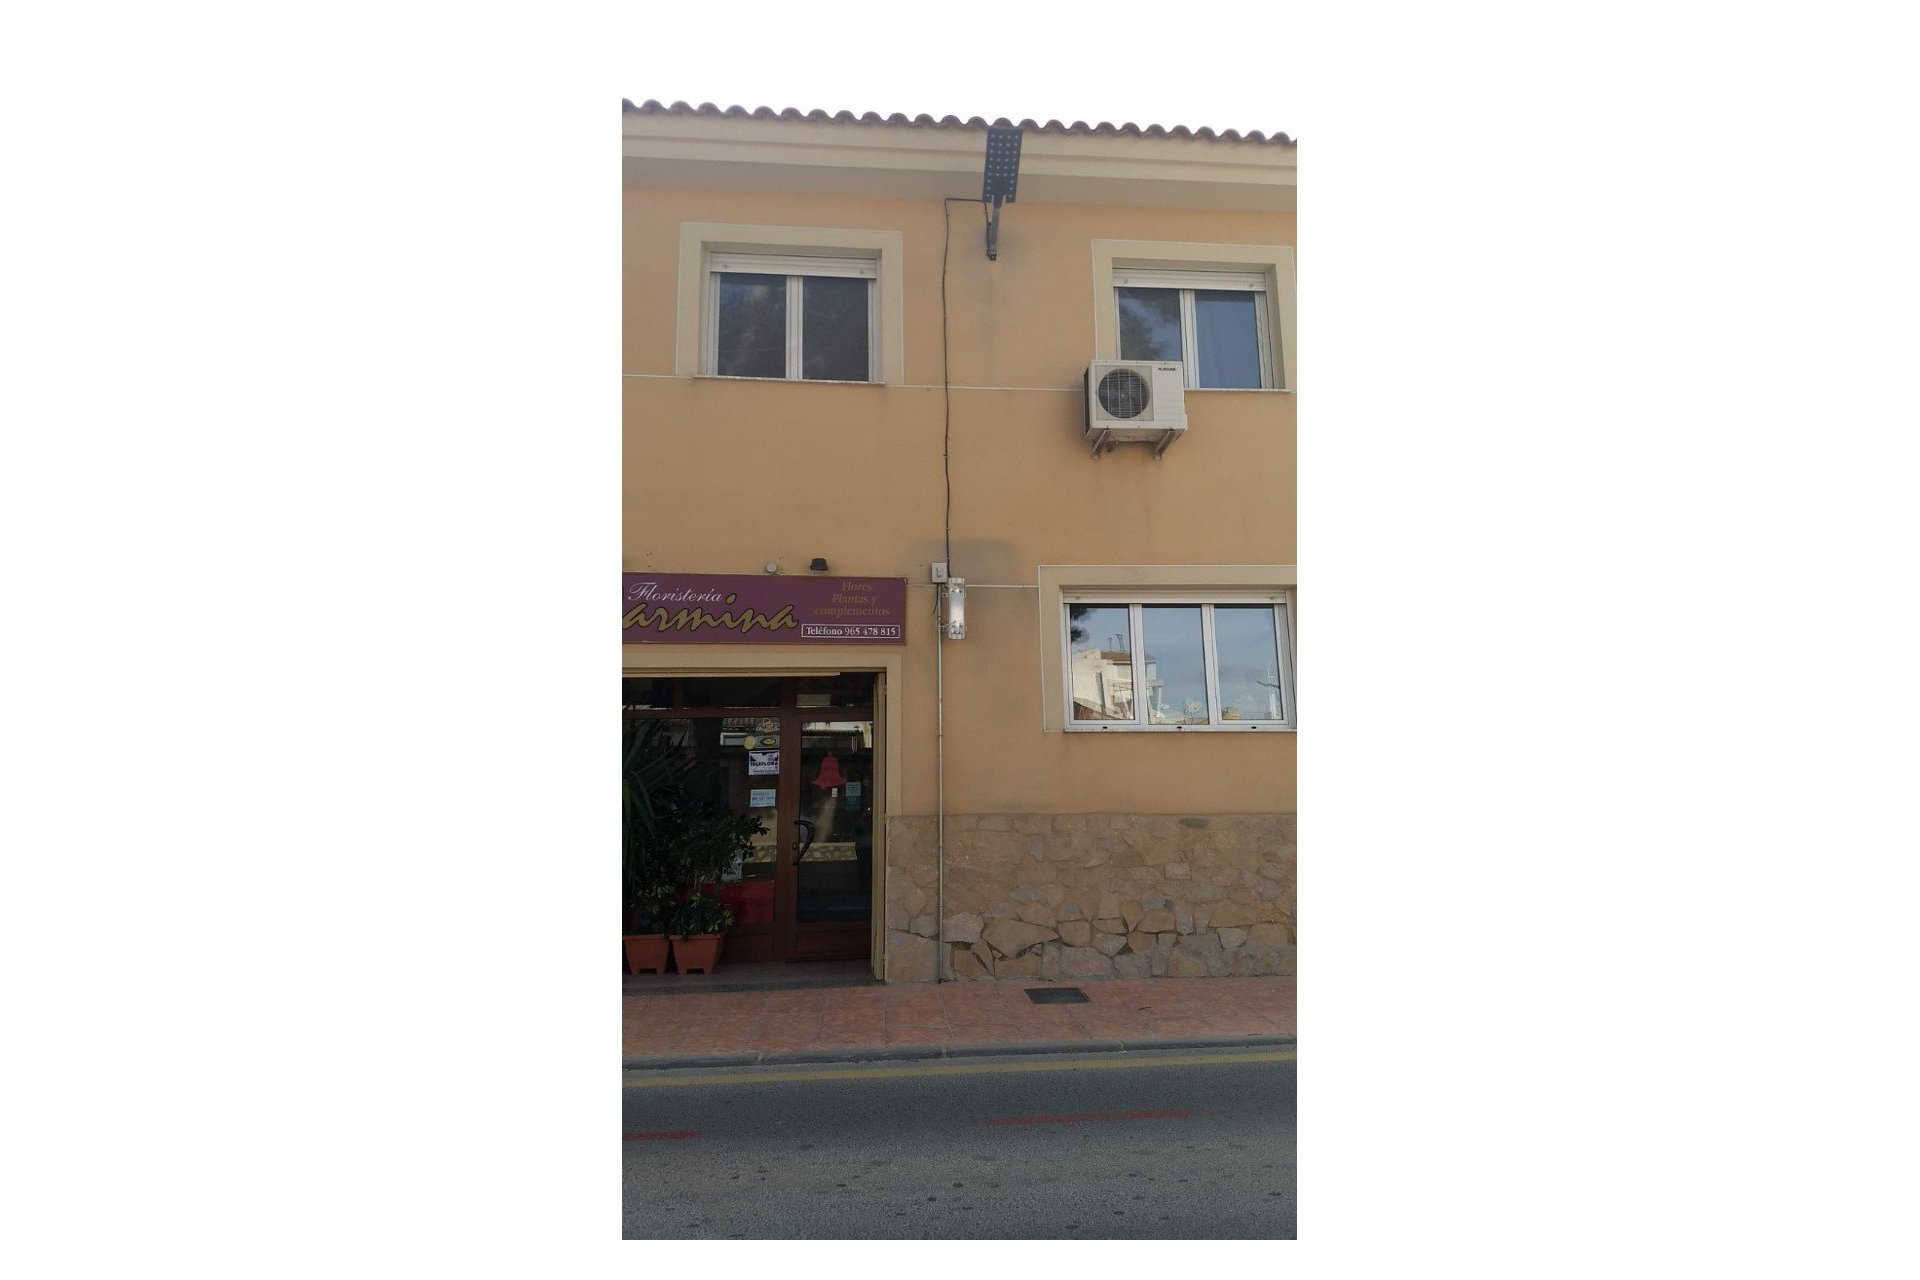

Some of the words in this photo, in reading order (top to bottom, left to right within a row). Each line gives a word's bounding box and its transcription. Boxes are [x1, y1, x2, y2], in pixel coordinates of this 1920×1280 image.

[628, 582, 723, 602] Floristería
[842, 581, 872, 592] Flores
[832, 593, 869, 604] Plantas
[872, 595, 878, 606] y
[622, 588, 799, 633] armina
[815, 607, 890, 618] complementos
[806, 626, 843, 636] Teléfono
[845, 627, 860, 636] 965
[863, 627, 878, 636] 478
[881, 627, 896, 636] 815
